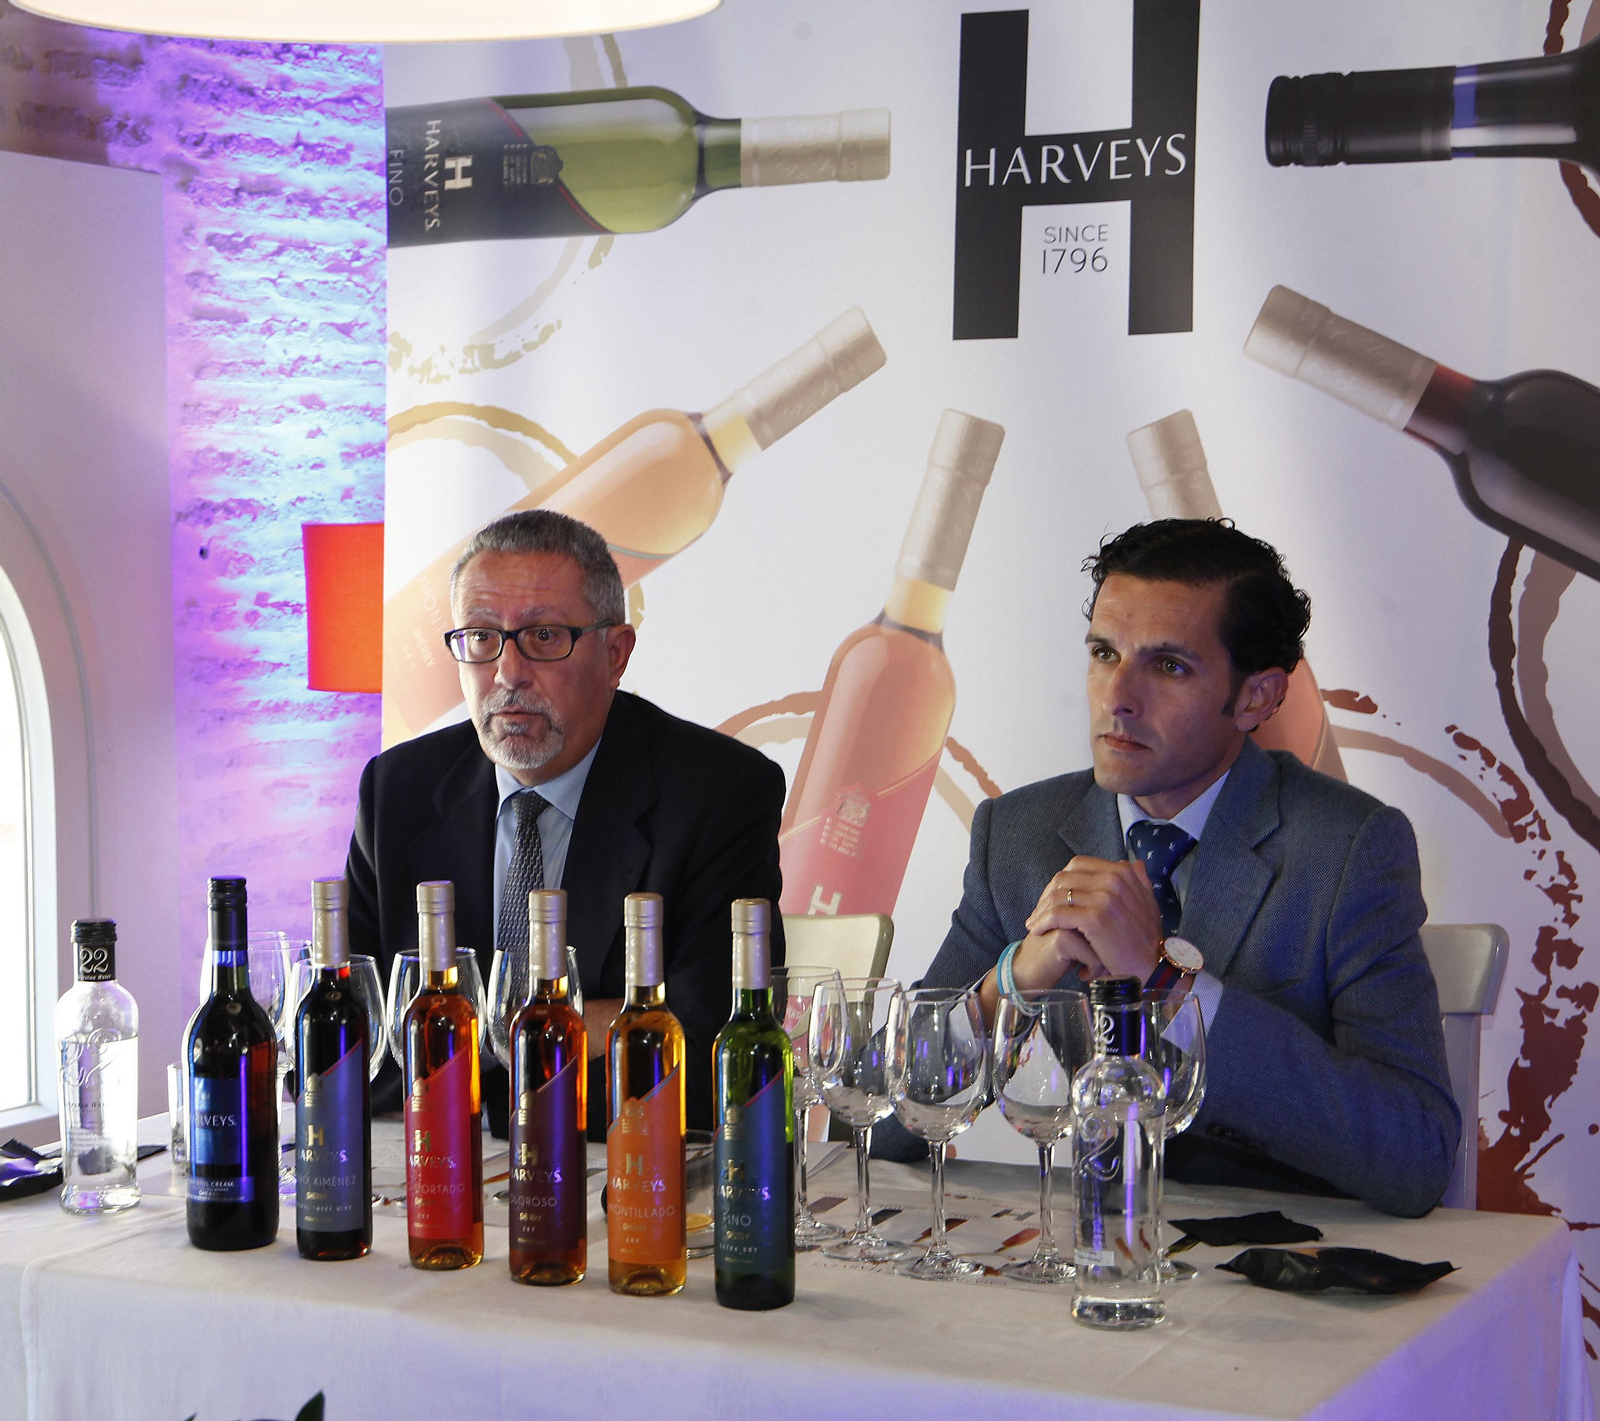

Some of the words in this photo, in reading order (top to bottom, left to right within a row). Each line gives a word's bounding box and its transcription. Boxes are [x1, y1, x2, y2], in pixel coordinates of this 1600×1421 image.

[444, 154, 474, 191] H
[964, 133, 1188, 187] HARVEYS
[388, 149, 404, 207] FINO
[423, 119, 442, 232] HARVEYS
[1043, 223, 1109, 245] SINCE
[1042, 246, 1108, 275] 1796
[806, 883, 842, 916] H
[79, 945, 109, 974] 22
[307, 1124, 324, 1147] H
[414, 1129, 431, 1152] H
[521, 1142, 538, 1166] H
[625, 1152, 643, 1175] H
[725, 1158, 746, 1183] H
